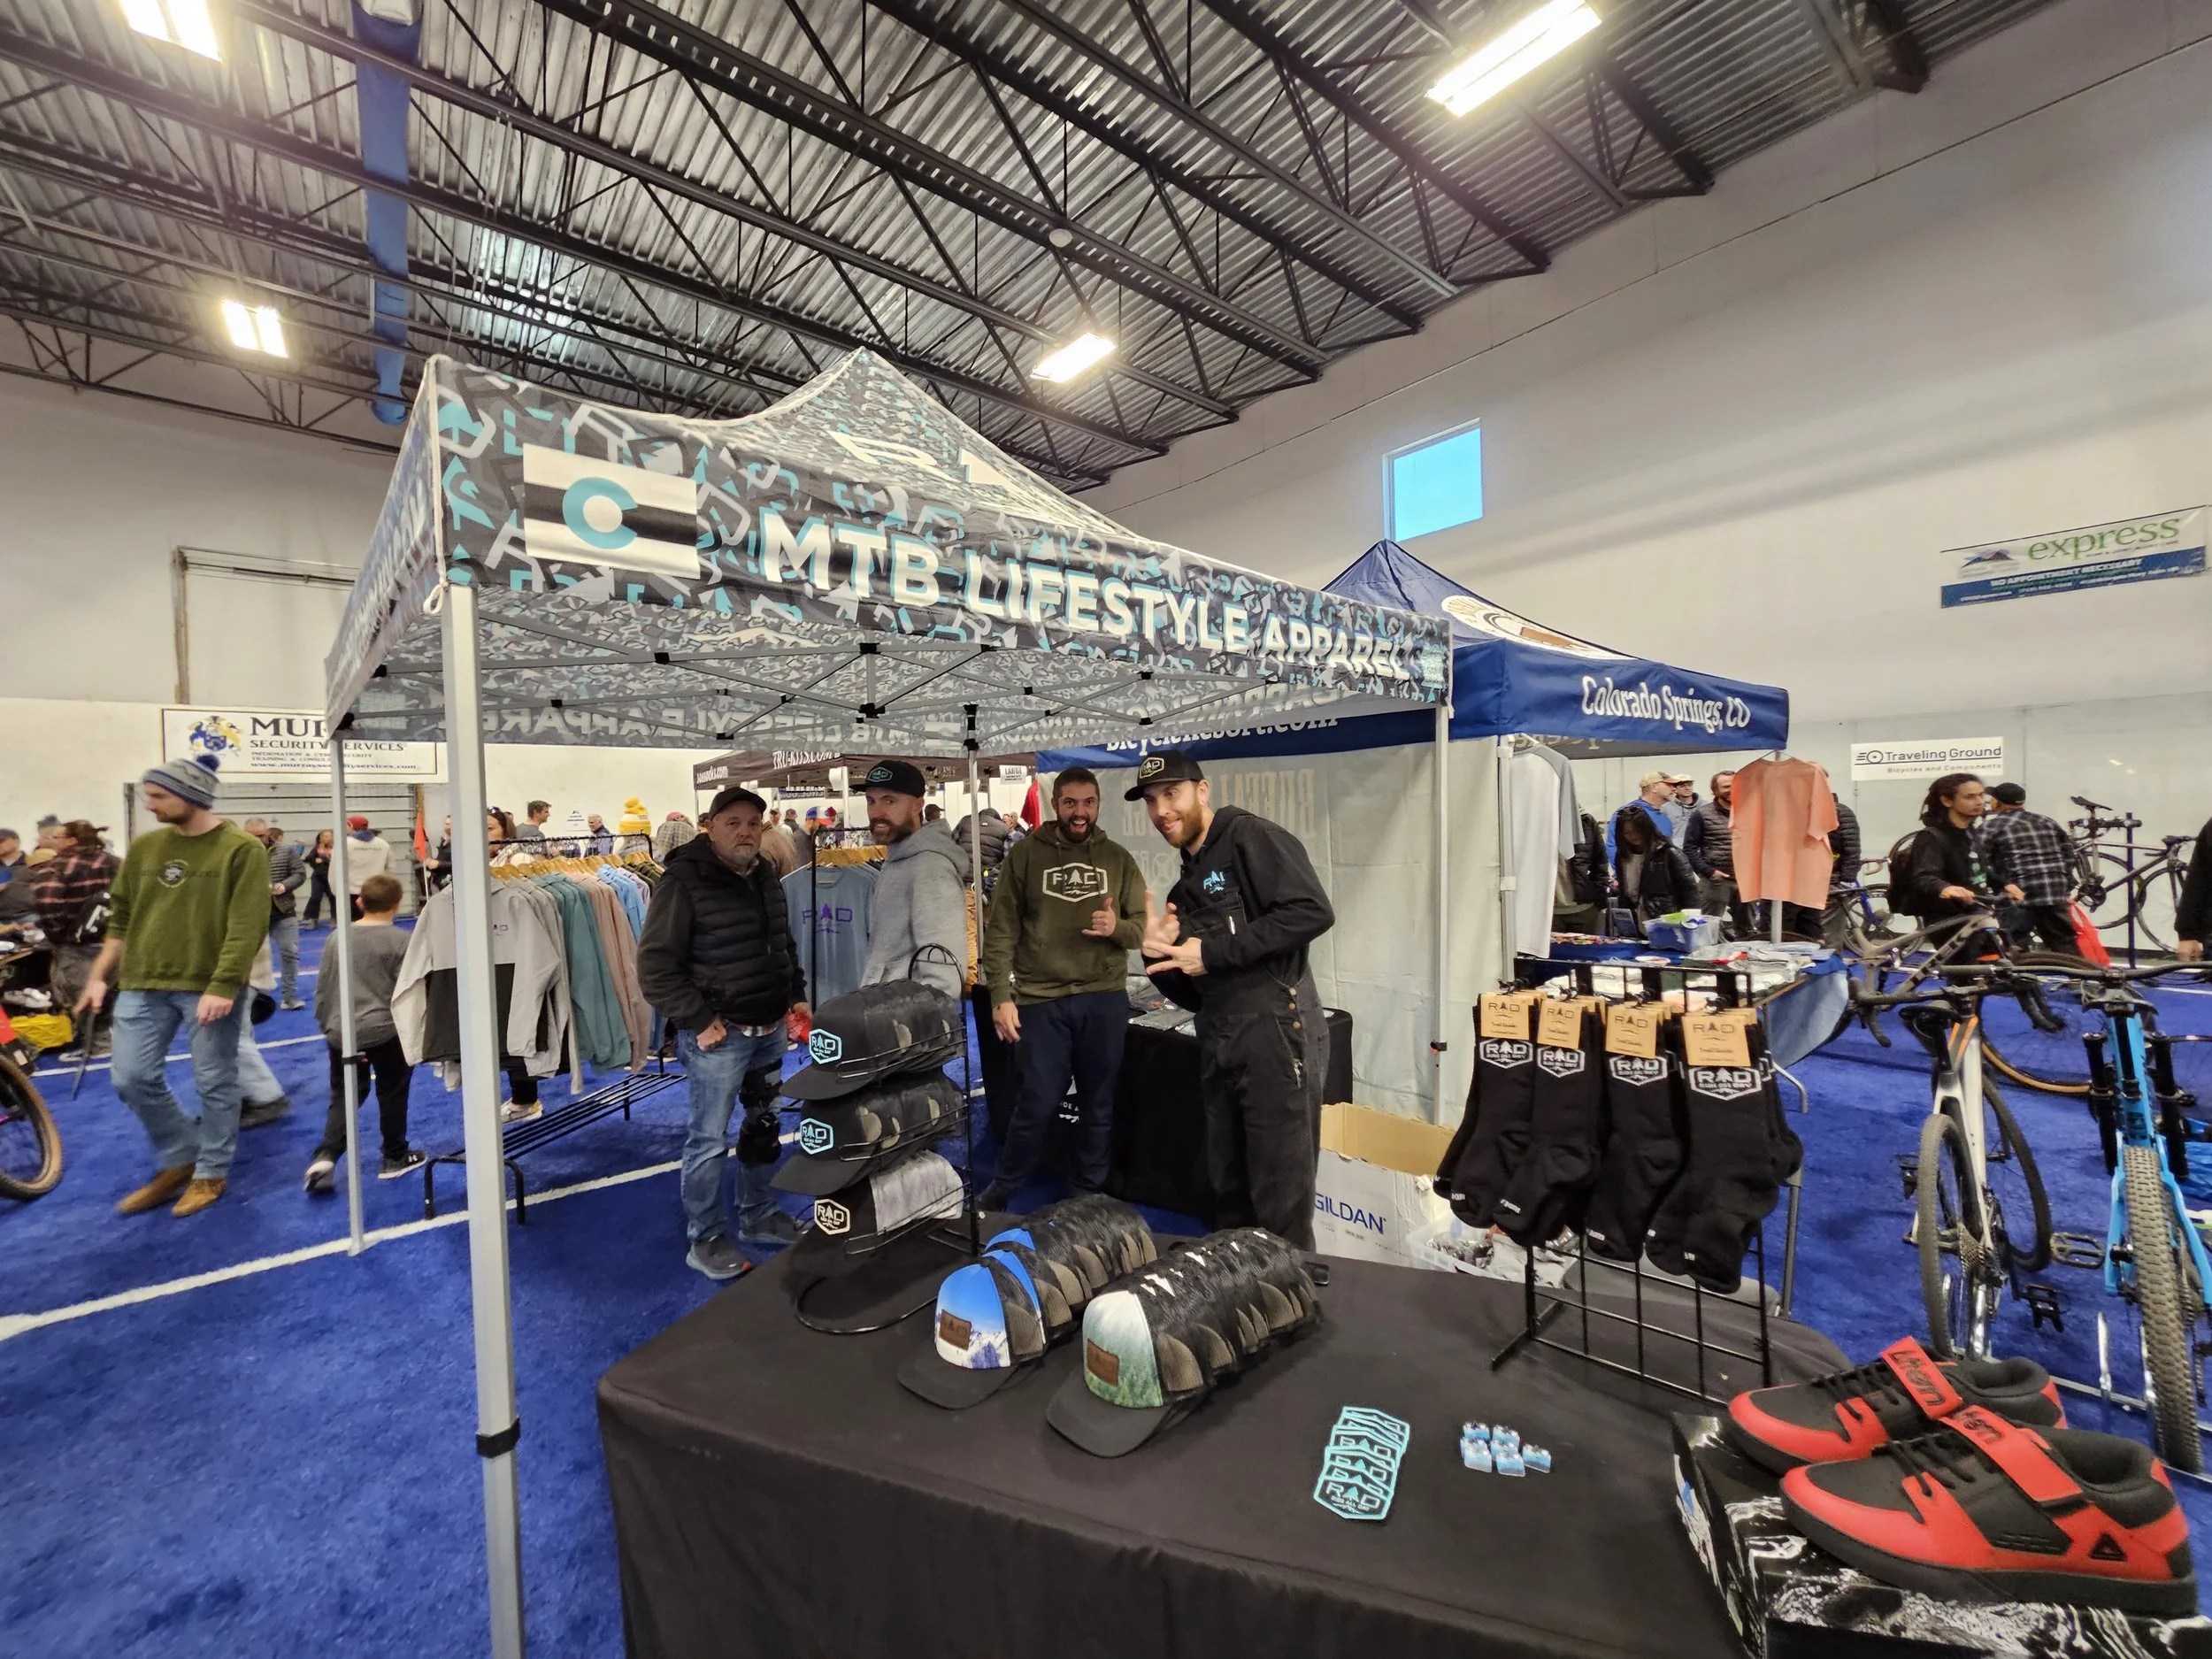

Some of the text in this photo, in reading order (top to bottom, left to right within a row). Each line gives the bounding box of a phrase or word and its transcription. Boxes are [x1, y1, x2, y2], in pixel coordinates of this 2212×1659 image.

[2028, 518, 2180, 561] express
[759, 507, 940, 607] MTB
[964, 549, 1252, 655] LIFESTYLE
[1258, 612, 1410, 680] APPAREL
[1582, 675, 1751, 733] Colorado Springs, CO
[250, 740, 404, 751] SECURITY ERVICES
[1886, 746, 2001, 761] Traveling Ground
[1489, 1002, 1520, 1012] RAD
[1615, 1015, 1648, 1028] RAD
[1693, 1022, 1735, 1033] RAD
[812, 1034, 836, 1051] RAD
[1486, 1041, 1527, 1054] RAD
[1543, 1048, 1578, 1062] RAD
[1617, 1057, 1659, 1071] RAD
[1698, 1067, 1752, 1083] RAD
[802, 1124, 827, 1140] RAD
[818, 1205, 844, 1223] RAD
[1315, 1193, 1384, 1235] GILDAN
[1326, 1482, 1381, 1509] RAD
